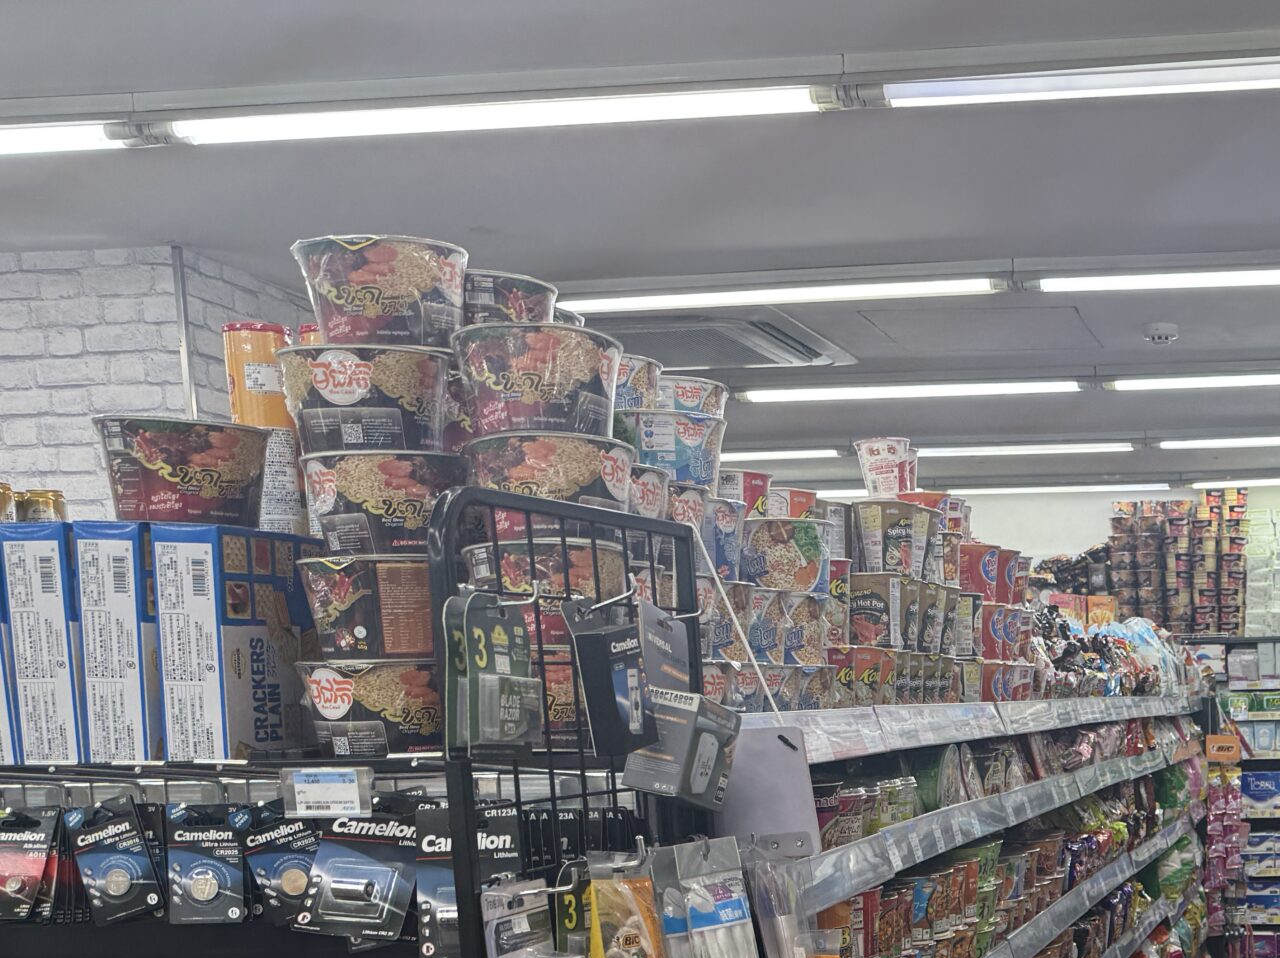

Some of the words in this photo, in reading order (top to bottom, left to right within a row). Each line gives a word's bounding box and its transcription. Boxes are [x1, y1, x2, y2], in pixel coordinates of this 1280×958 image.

[474, 624, 487, 668] 3
[611, 638, 639, 653] Camelion
[249, 637, 269, 743] CRACKERS
[501, 695, 521, 708] BLADE
[268, 683, 284, 742] PLAIN
[500, 708, 521, 721] RAZOR
[485, 809, 517, 817] CR123A
[0, 831, 45, 841] amelion
[77, 822, 130, 846] Camelion
[174, 830, 232, 842] Camelion
[246, 822, 303, 847] Camelion
[421, 834, 511, 852] Calion
[564, 894, 577, 929] 3
[622, 934, 641, 947] BIC
